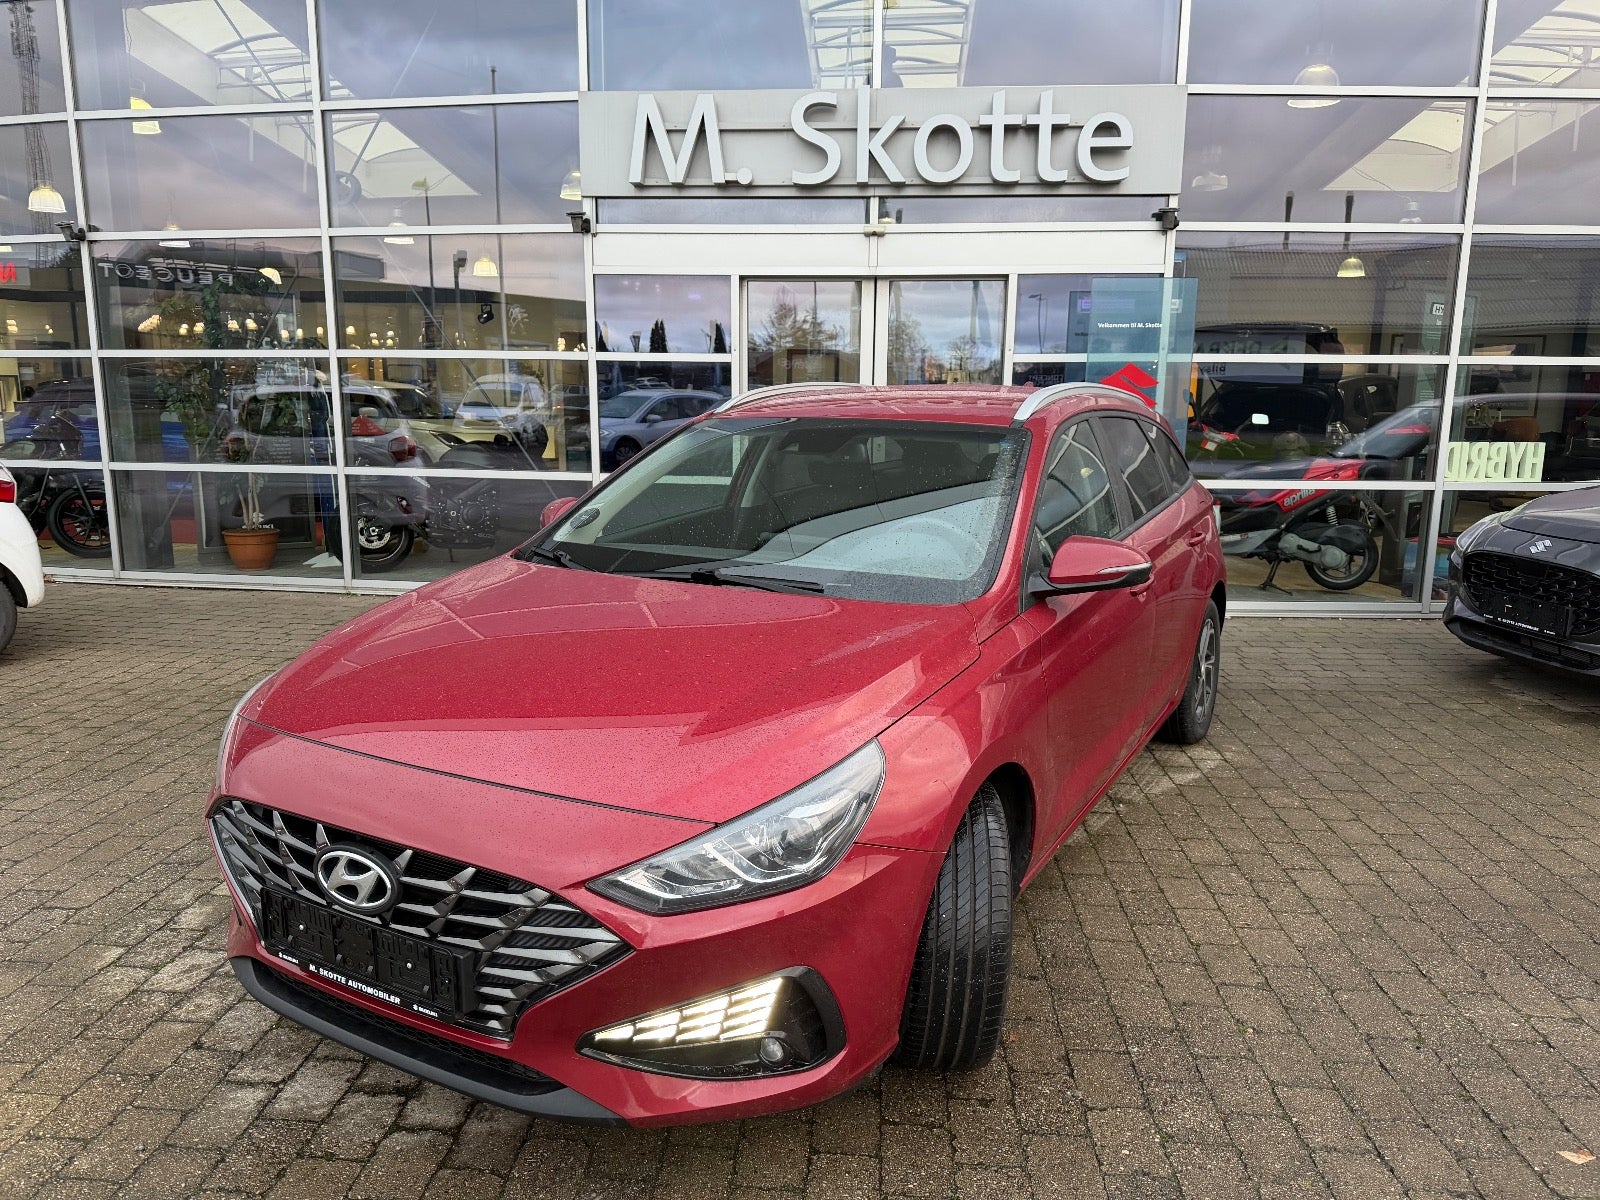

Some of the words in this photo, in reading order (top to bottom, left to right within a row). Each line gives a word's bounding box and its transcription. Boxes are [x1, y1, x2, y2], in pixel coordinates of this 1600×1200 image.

[629, 93, 753, 187] M.
[791, 85, 1134, 187] Skotte
[1284, 489, 1316, 507] aprilia
[309, 963, 318, 973] M.
[319, 967, 346, 984] SKOTTE
[347, 979, 401, 1005] AUTOMOBILER
